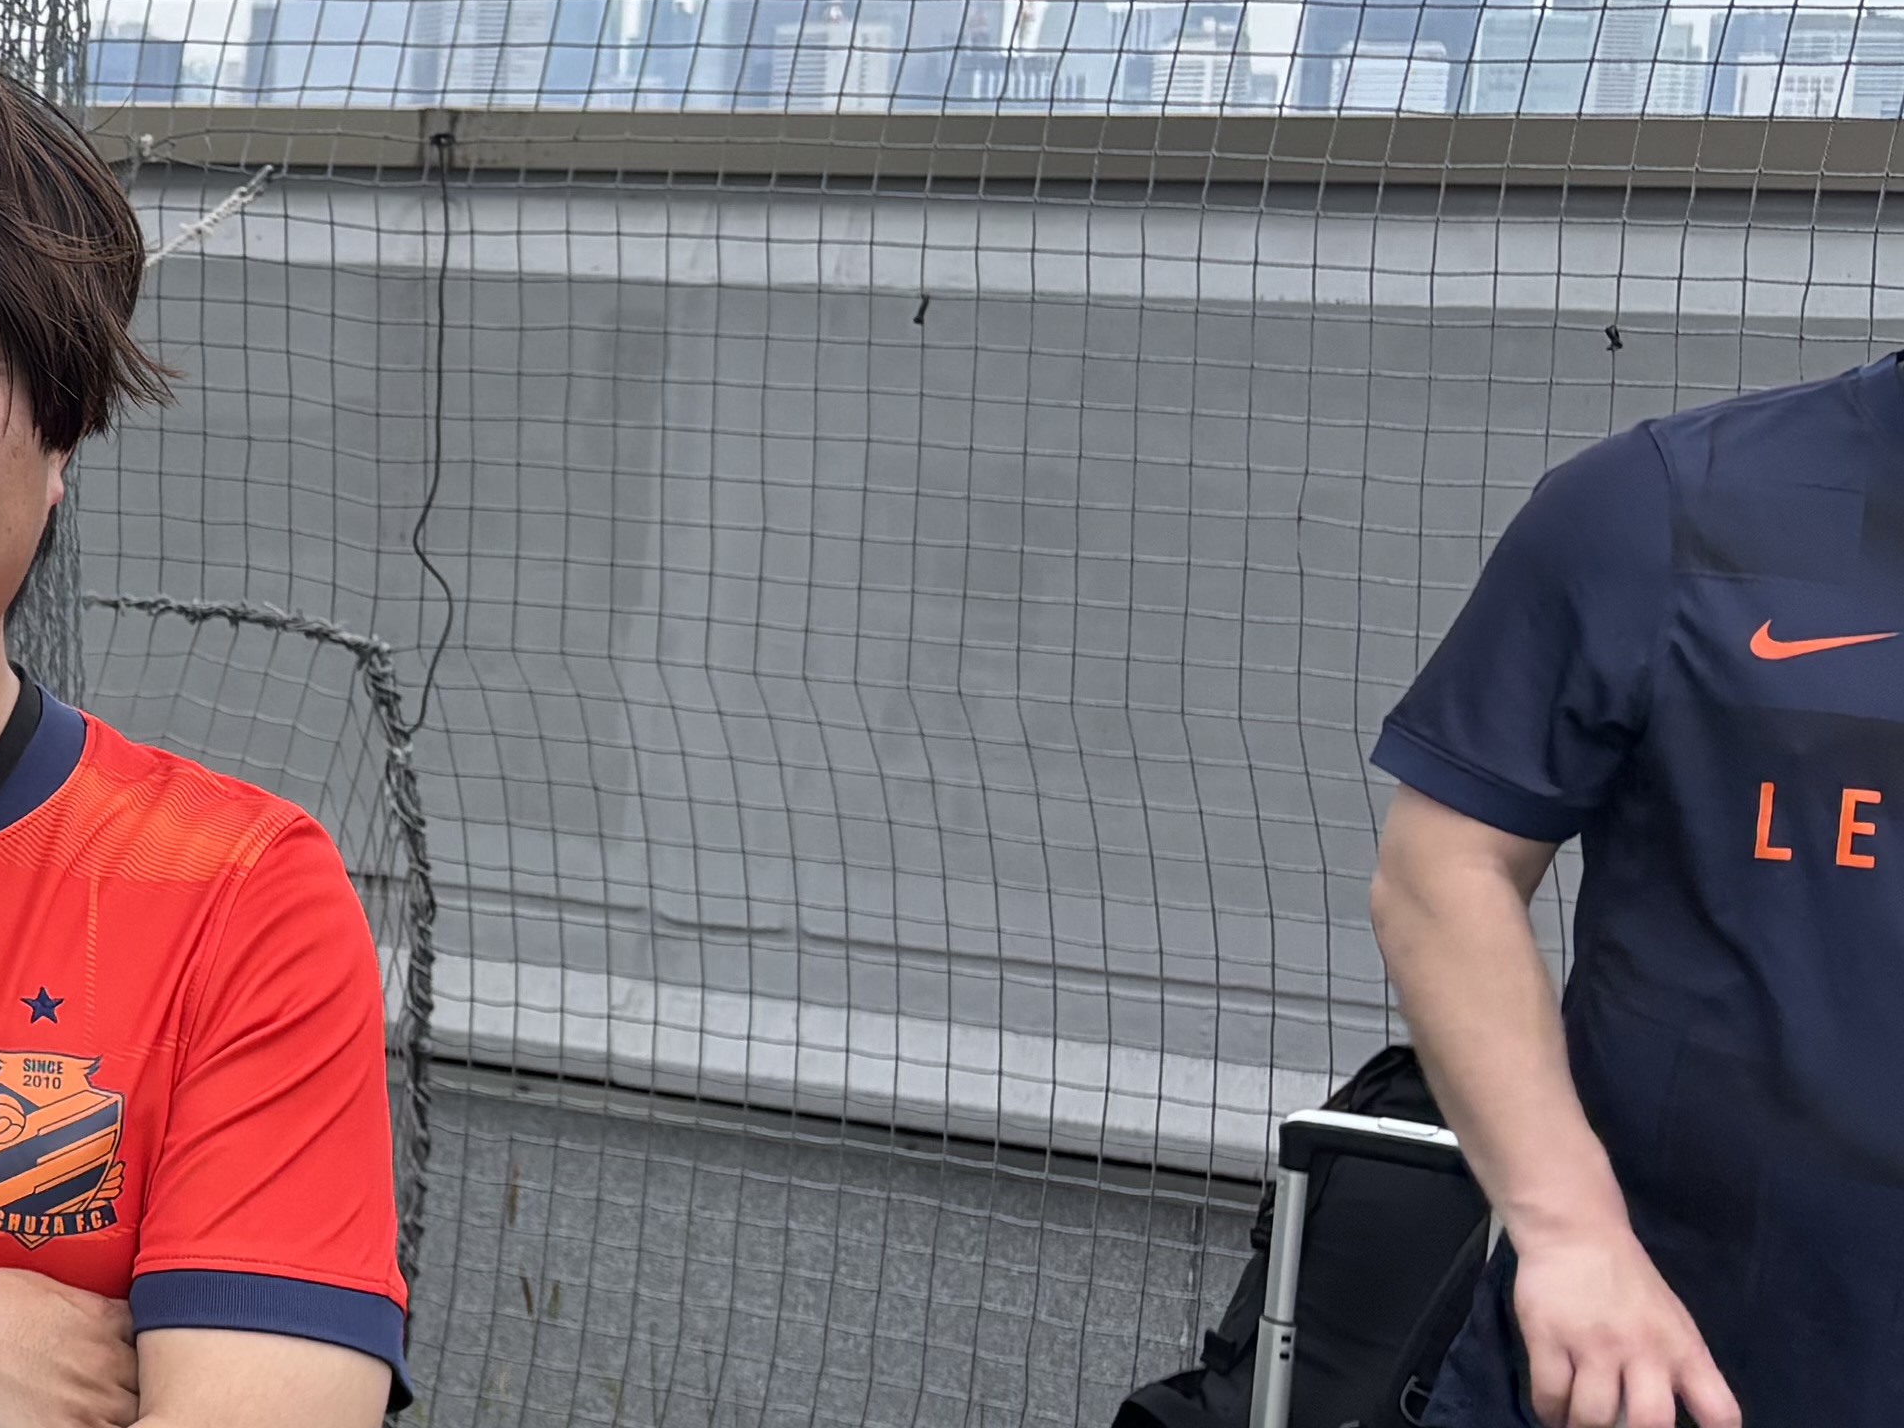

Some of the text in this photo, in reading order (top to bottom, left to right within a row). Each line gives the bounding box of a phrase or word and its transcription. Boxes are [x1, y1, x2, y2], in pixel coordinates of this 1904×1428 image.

[1754, 781, 1882, 869] LE
[22, 1058, 63, 1075] SINCE
[22, 1075, 62, 1090] 2010
[77, 1209, 110, 1233] F.C.
